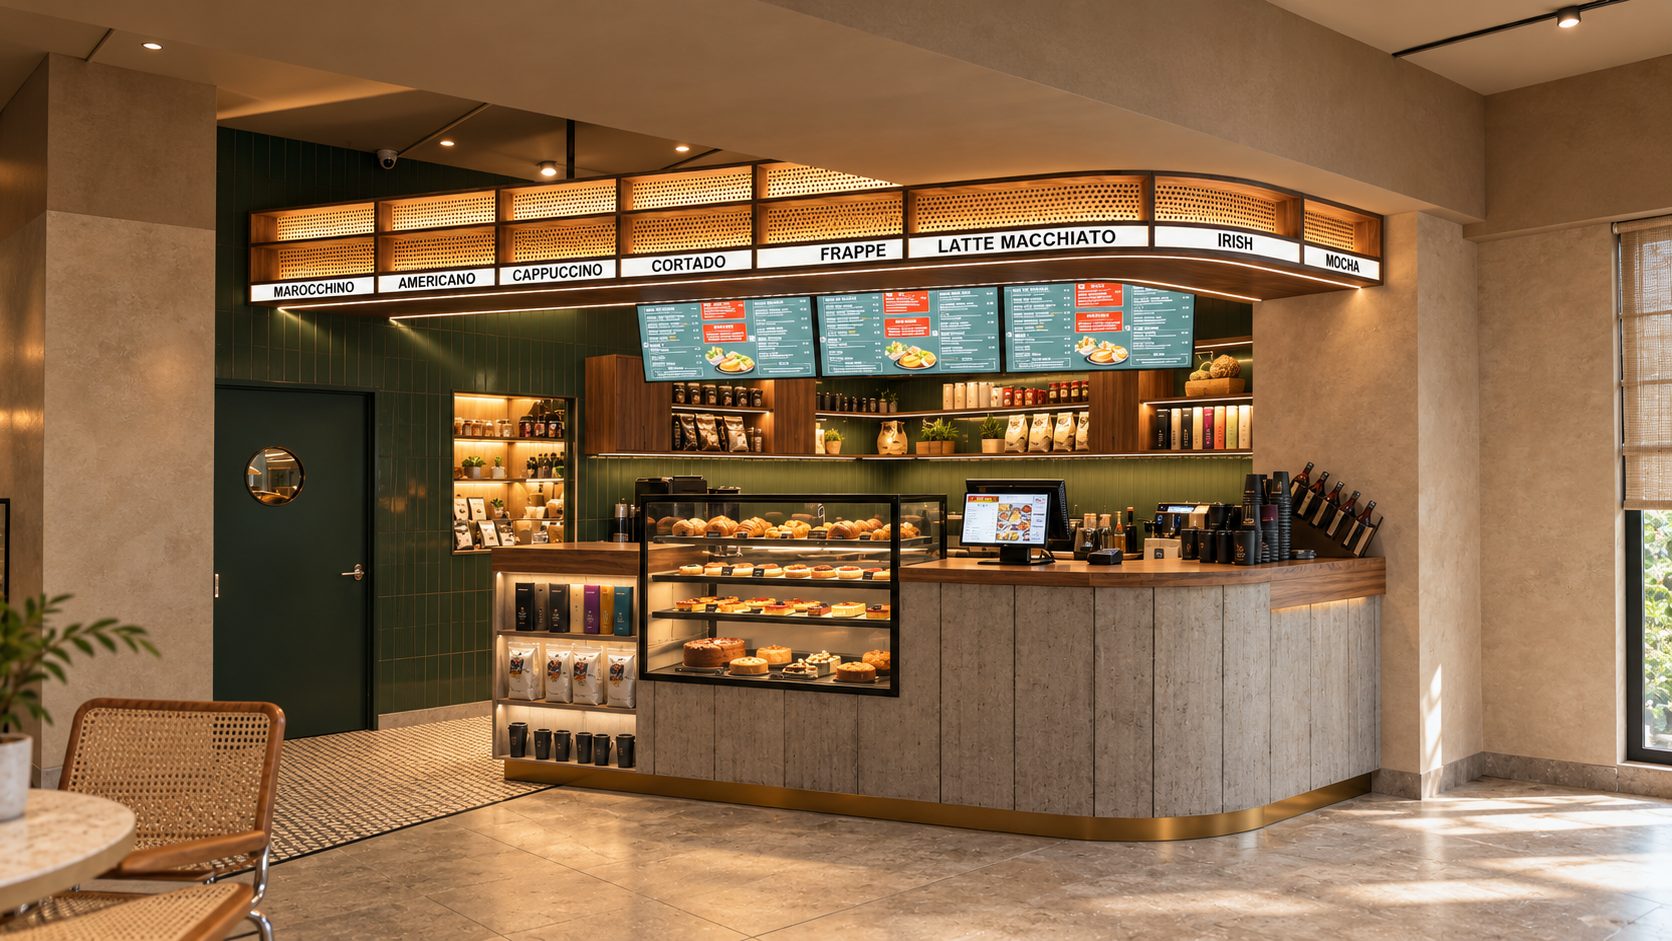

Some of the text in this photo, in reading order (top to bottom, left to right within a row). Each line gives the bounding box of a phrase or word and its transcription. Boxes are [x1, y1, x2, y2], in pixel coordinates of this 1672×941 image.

[938, 229, 1116, 254] LATTE MACCHIATO
[1218, 232, 1253, 251] IRISH
[820, 243, 887, 261] FRAPPE
[651, 255, 726, 273] CORTADO
[1325, 253, 1360, 273] MOCHA
[398, 272, 476, 289] AMERICANO
[512, 263, 603, 282] CAPPUCCINO
[273, 281, 355, 298] MAROCCHINO
